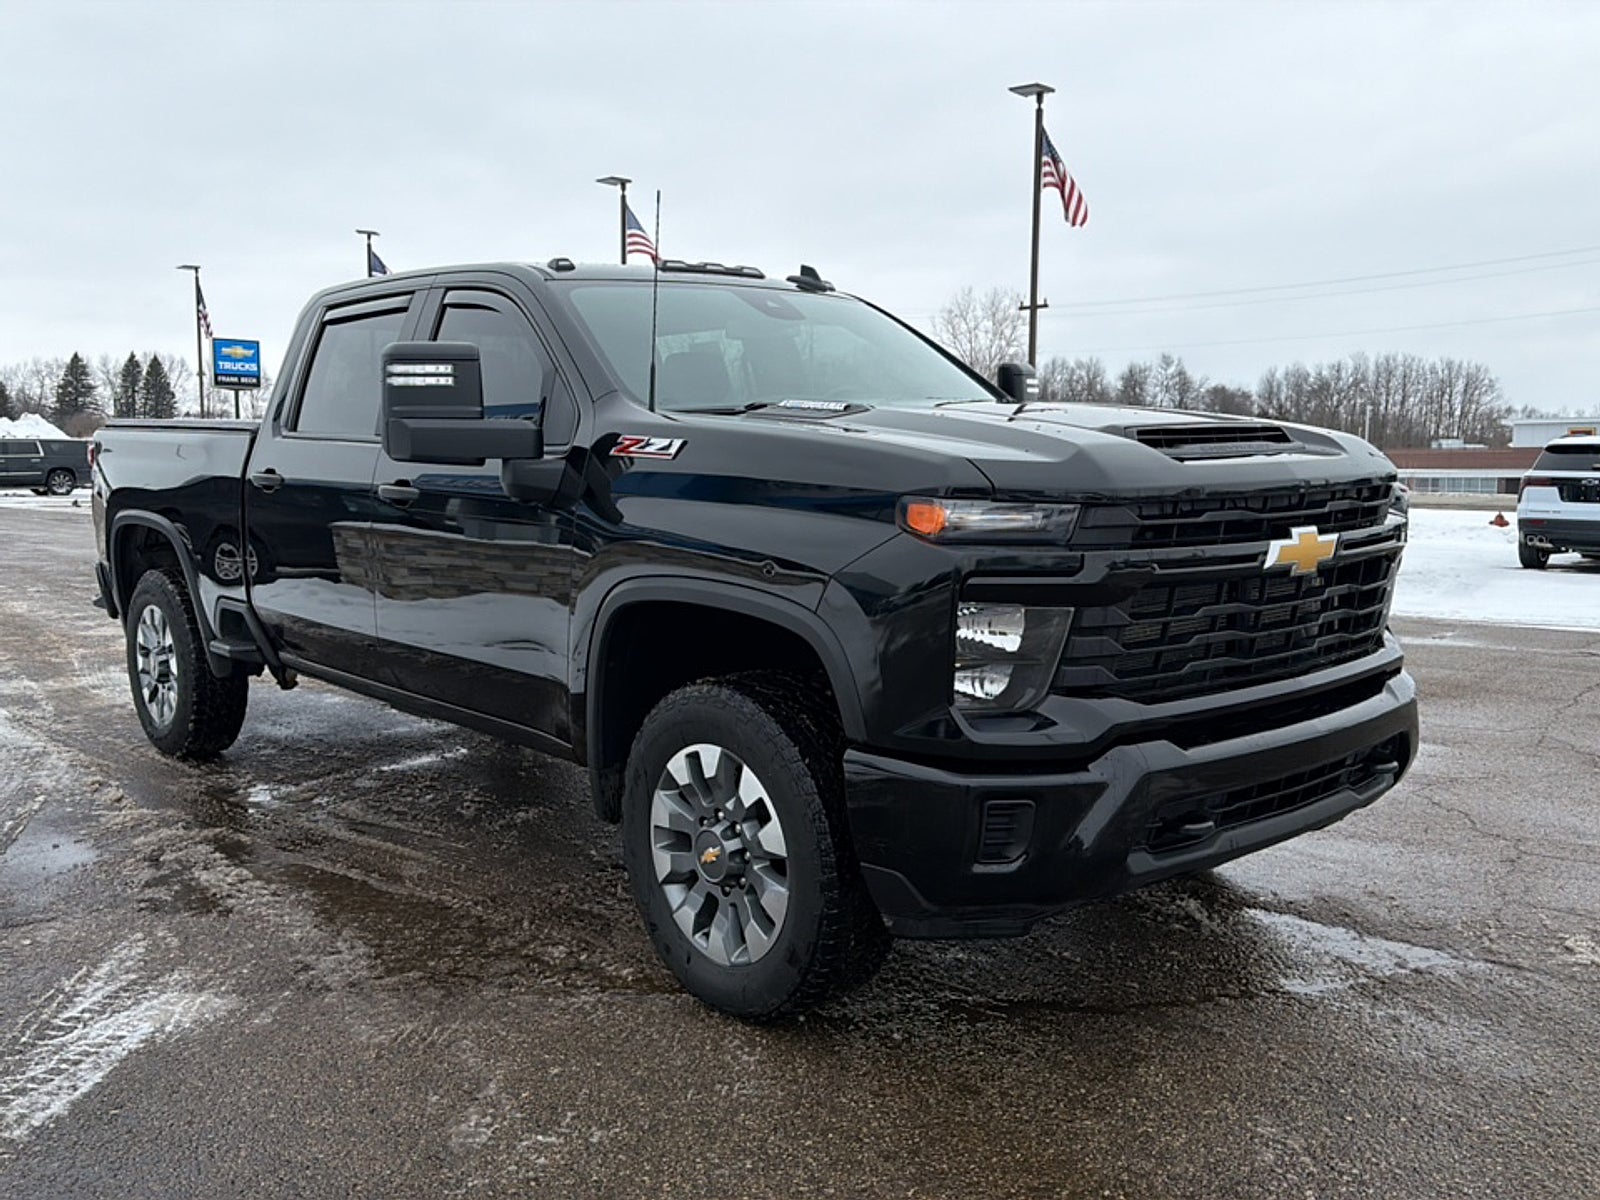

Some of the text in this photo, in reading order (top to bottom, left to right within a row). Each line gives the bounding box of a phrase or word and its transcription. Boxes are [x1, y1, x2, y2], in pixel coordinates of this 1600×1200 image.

[218, 361, 257, 371] TRUCKS
[217, 375, 239, 383] FRANK
[608, 435, 686, 460] Z71
